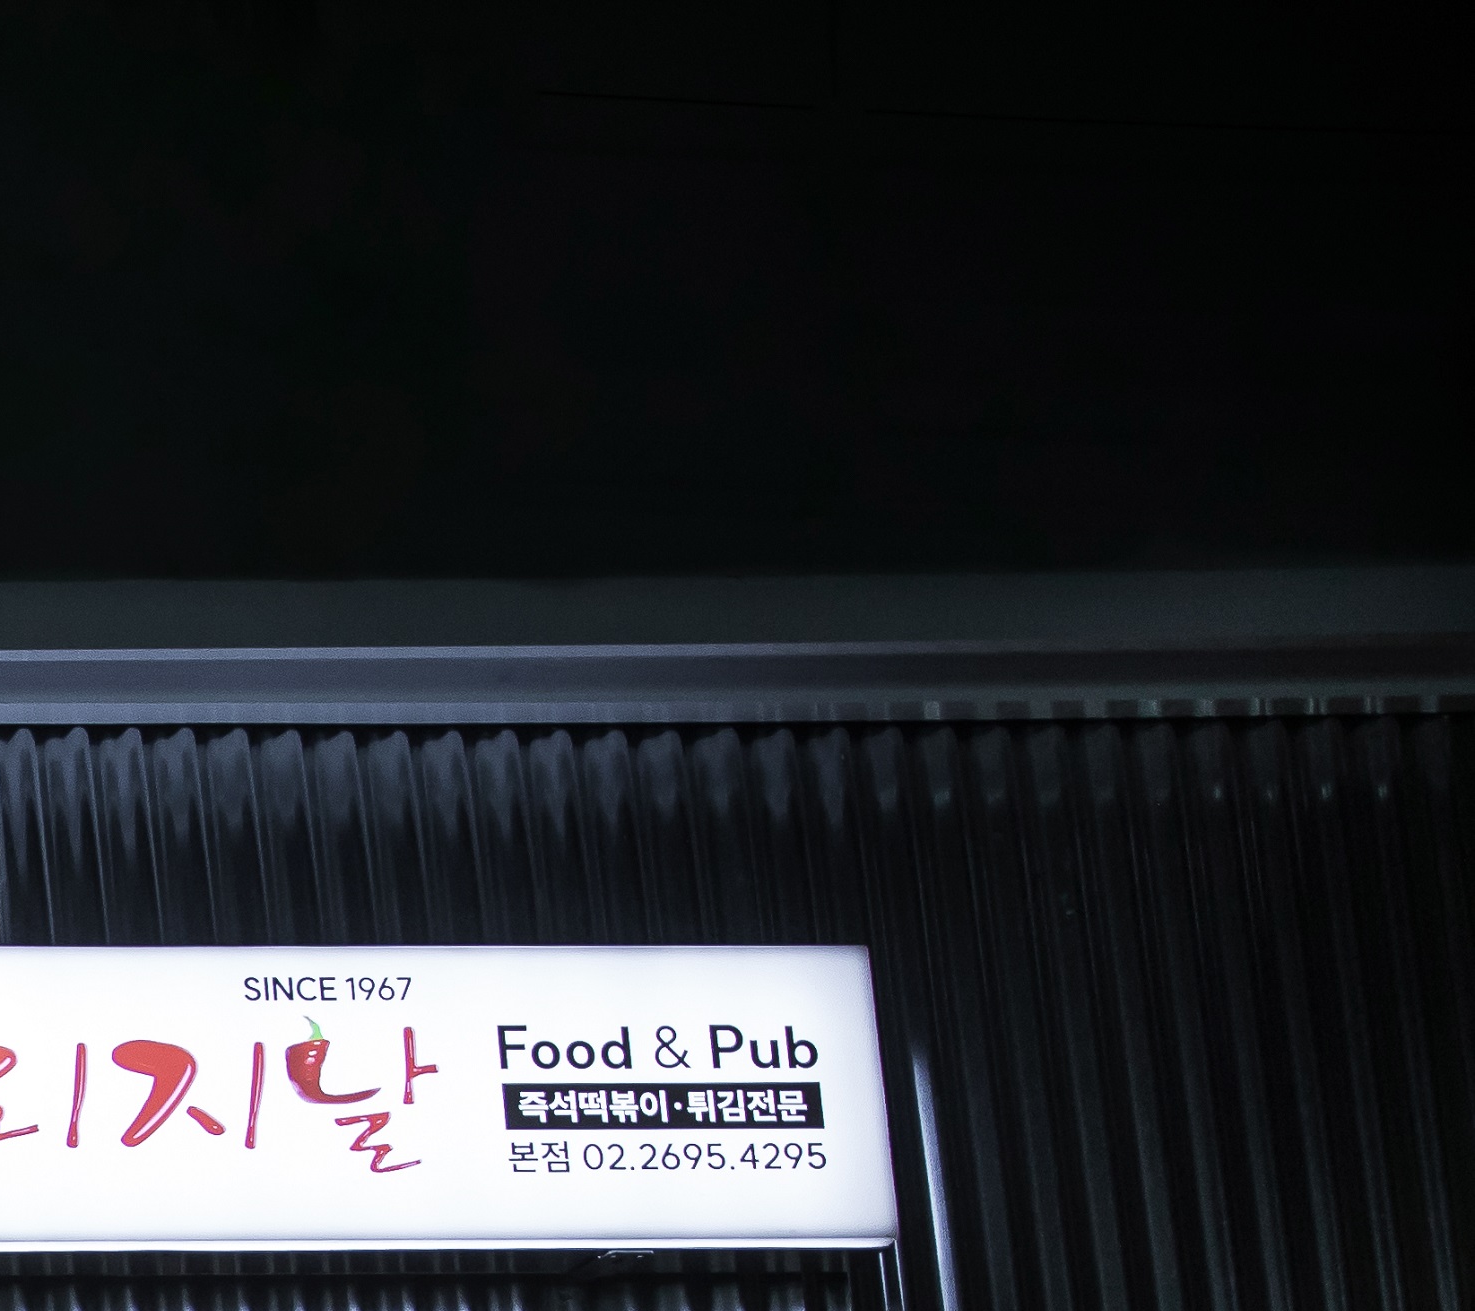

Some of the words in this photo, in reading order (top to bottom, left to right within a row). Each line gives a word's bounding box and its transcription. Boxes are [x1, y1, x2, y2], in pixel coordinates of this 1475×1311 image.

[243, 976, 337, 1001] SINCE
[345, 976, 412, 1001] 1967
[496, 1024, 634, 1070] Food
[655, 1025, 690, 1070] &
[709, 1024, 819, 1070] Pub
[508, 1142, 571, 1173] 본점
[583, 1142, 827, 1171] 02.2695.4295
